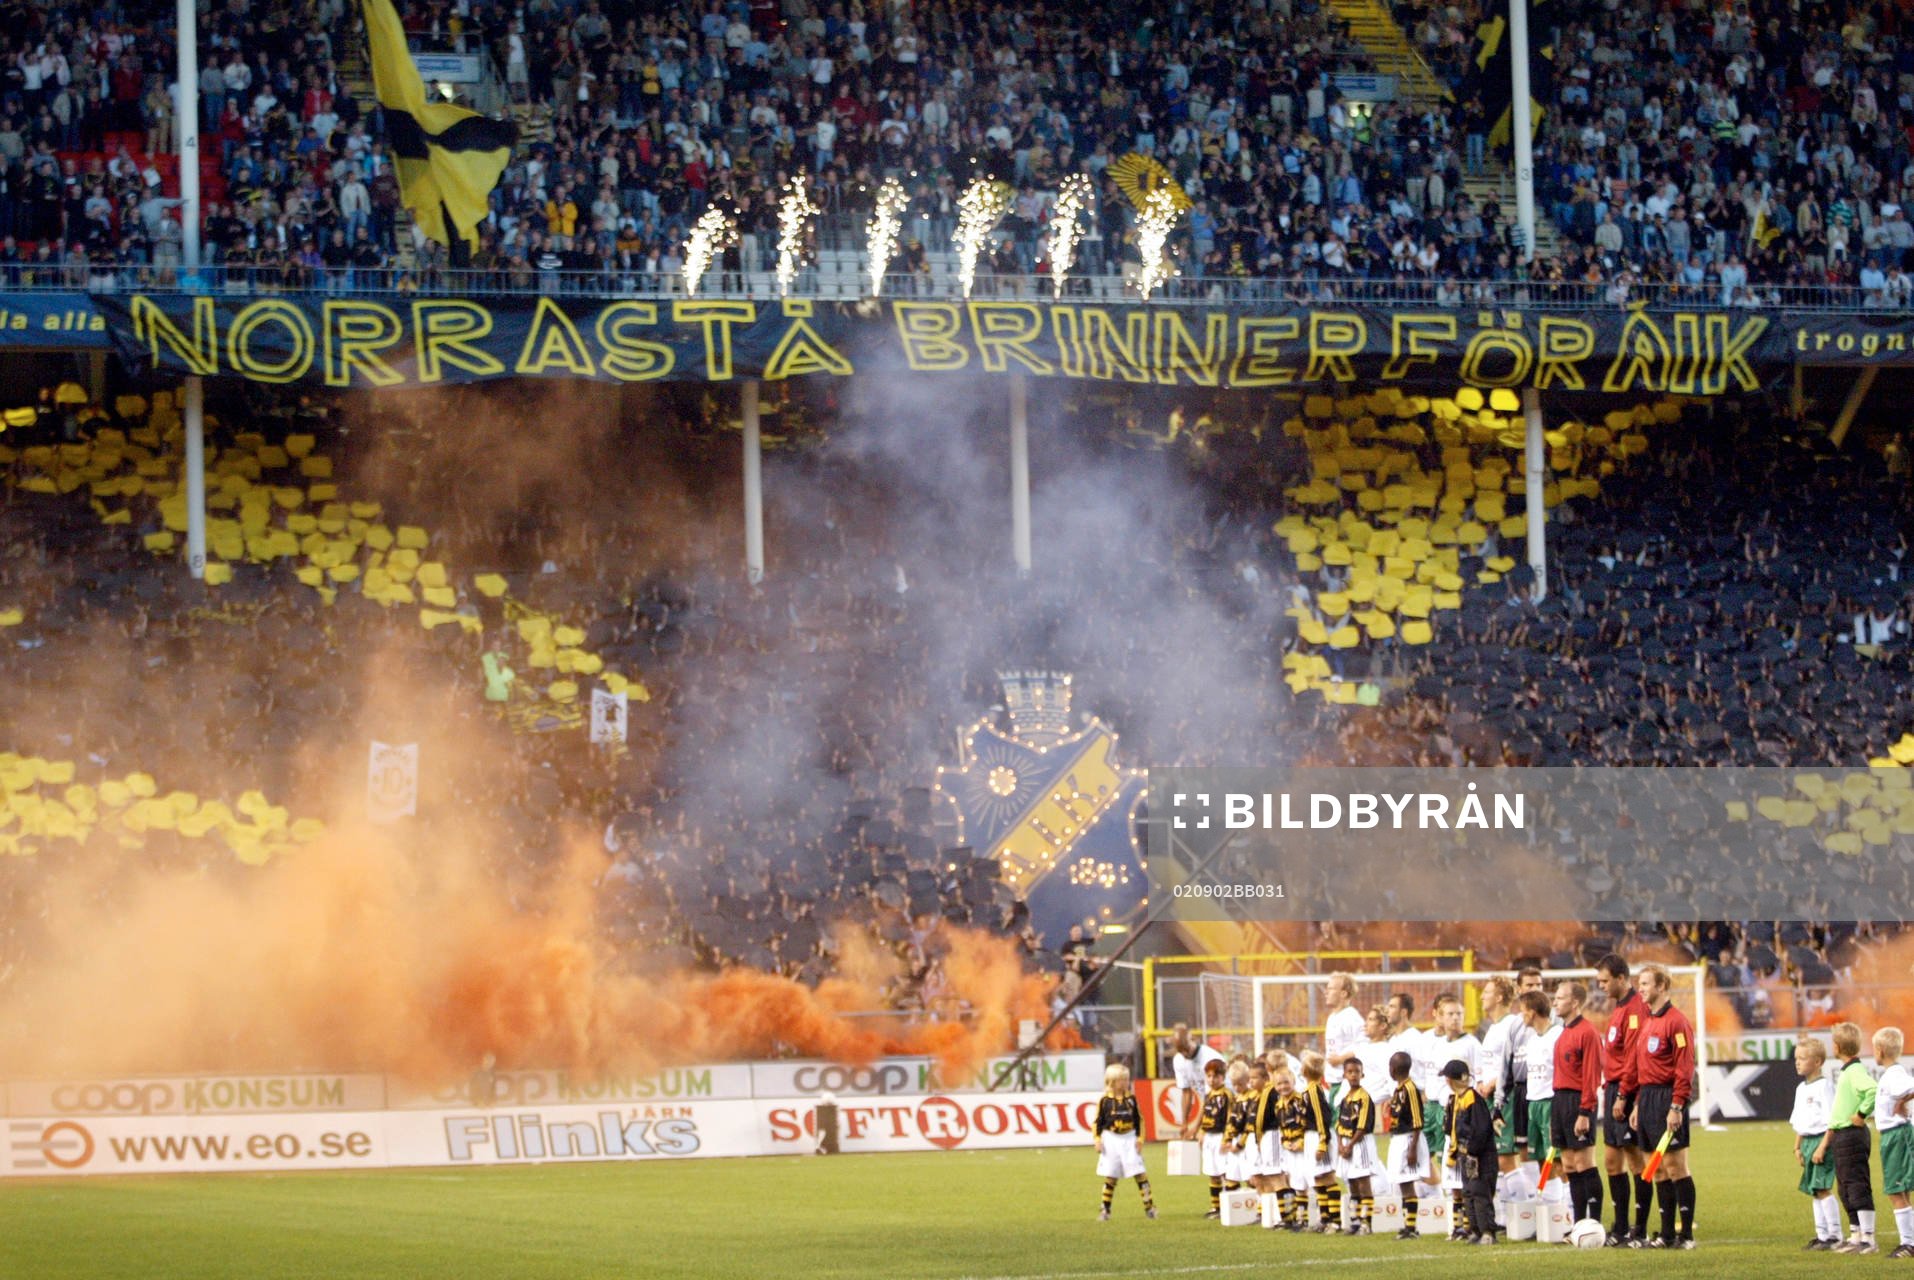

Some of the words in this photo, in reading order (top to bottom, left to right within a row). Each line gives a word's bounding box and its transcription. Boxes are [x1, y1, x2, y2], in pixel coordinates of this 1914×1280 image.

[43, 309, 106, 331] alla
[892, 301, 1368, 387] BRINNER
[1796, 328, 1914, 357] trogn
[793, 1065, 909, 1095] coop
[918, 1058, 1067, 1091] KNSUM
[51, 1083, 174, 1115] coop
[184, 1078, 346, 1110] KONSUM
[109, 1130, 373, 1163] www.eo.se
[444, 1110, 701, 1160] Flinks
